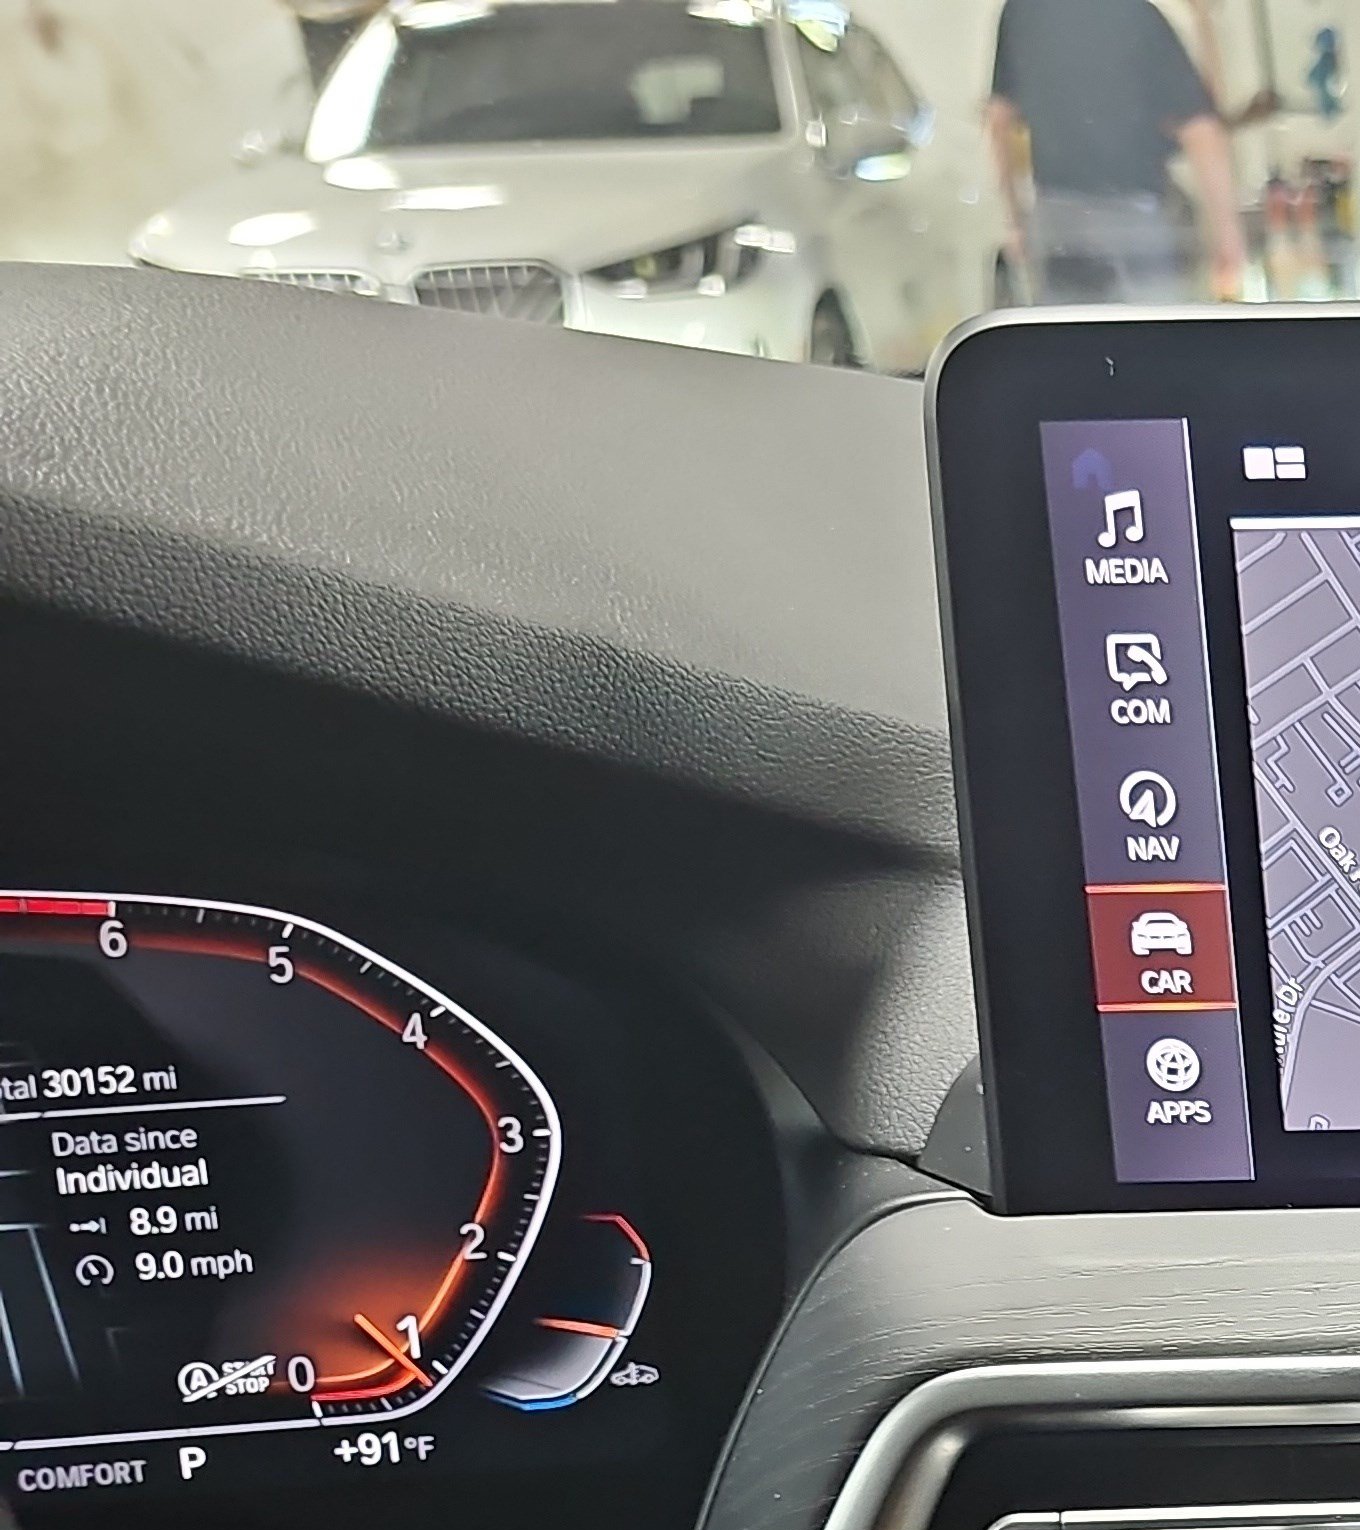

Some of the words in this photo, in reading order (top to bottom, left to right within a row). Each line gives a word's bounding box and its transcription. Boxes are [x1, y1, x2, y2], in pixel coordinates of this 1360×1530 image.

[1085, 557, 1169, 586] MEDIA
[1110, 698, 1171, 724] COM
[1127, 836, 1180, 862] NAV
[1318, 826, 1357, 874] Oak
[98, 919, 129, 959] 6
[267, 945, 296, 985] 5
[1141, 969, 1193, 995] CAR
[401, 1012, 428, 1049] 4
[0, 1073, 38, 1100] tal
[41, 1065, 137, 1098] 30152
[142, 1065, 178, 1091] mi
[1147, 1100, 1212, 1125] APPS
[51, 1130, 118, 1157] Data
[123, 1126, 198, 1152] since
[498, 1117, 525, 1154] 3
[56, 1157, 209, 1195] Individual
[129, 1205, 177, 1236] 8.9
[184, 1205, 219, 1231] mi
[459, 1224, 488, 1262] 2
[135, 1250, 184, 1281] 9.0
[190, 1248, 253, 1279] mph
[398, 1315, 424, 1359] 1
[225, 1376, 270, 1395] STOP
[288, 1355, 315, 1392] 0
[179, 1446, 207, 1480] P
[333, 1431, 401, 1466] +91
[17, 1459, 147, 1492] COMFORT
